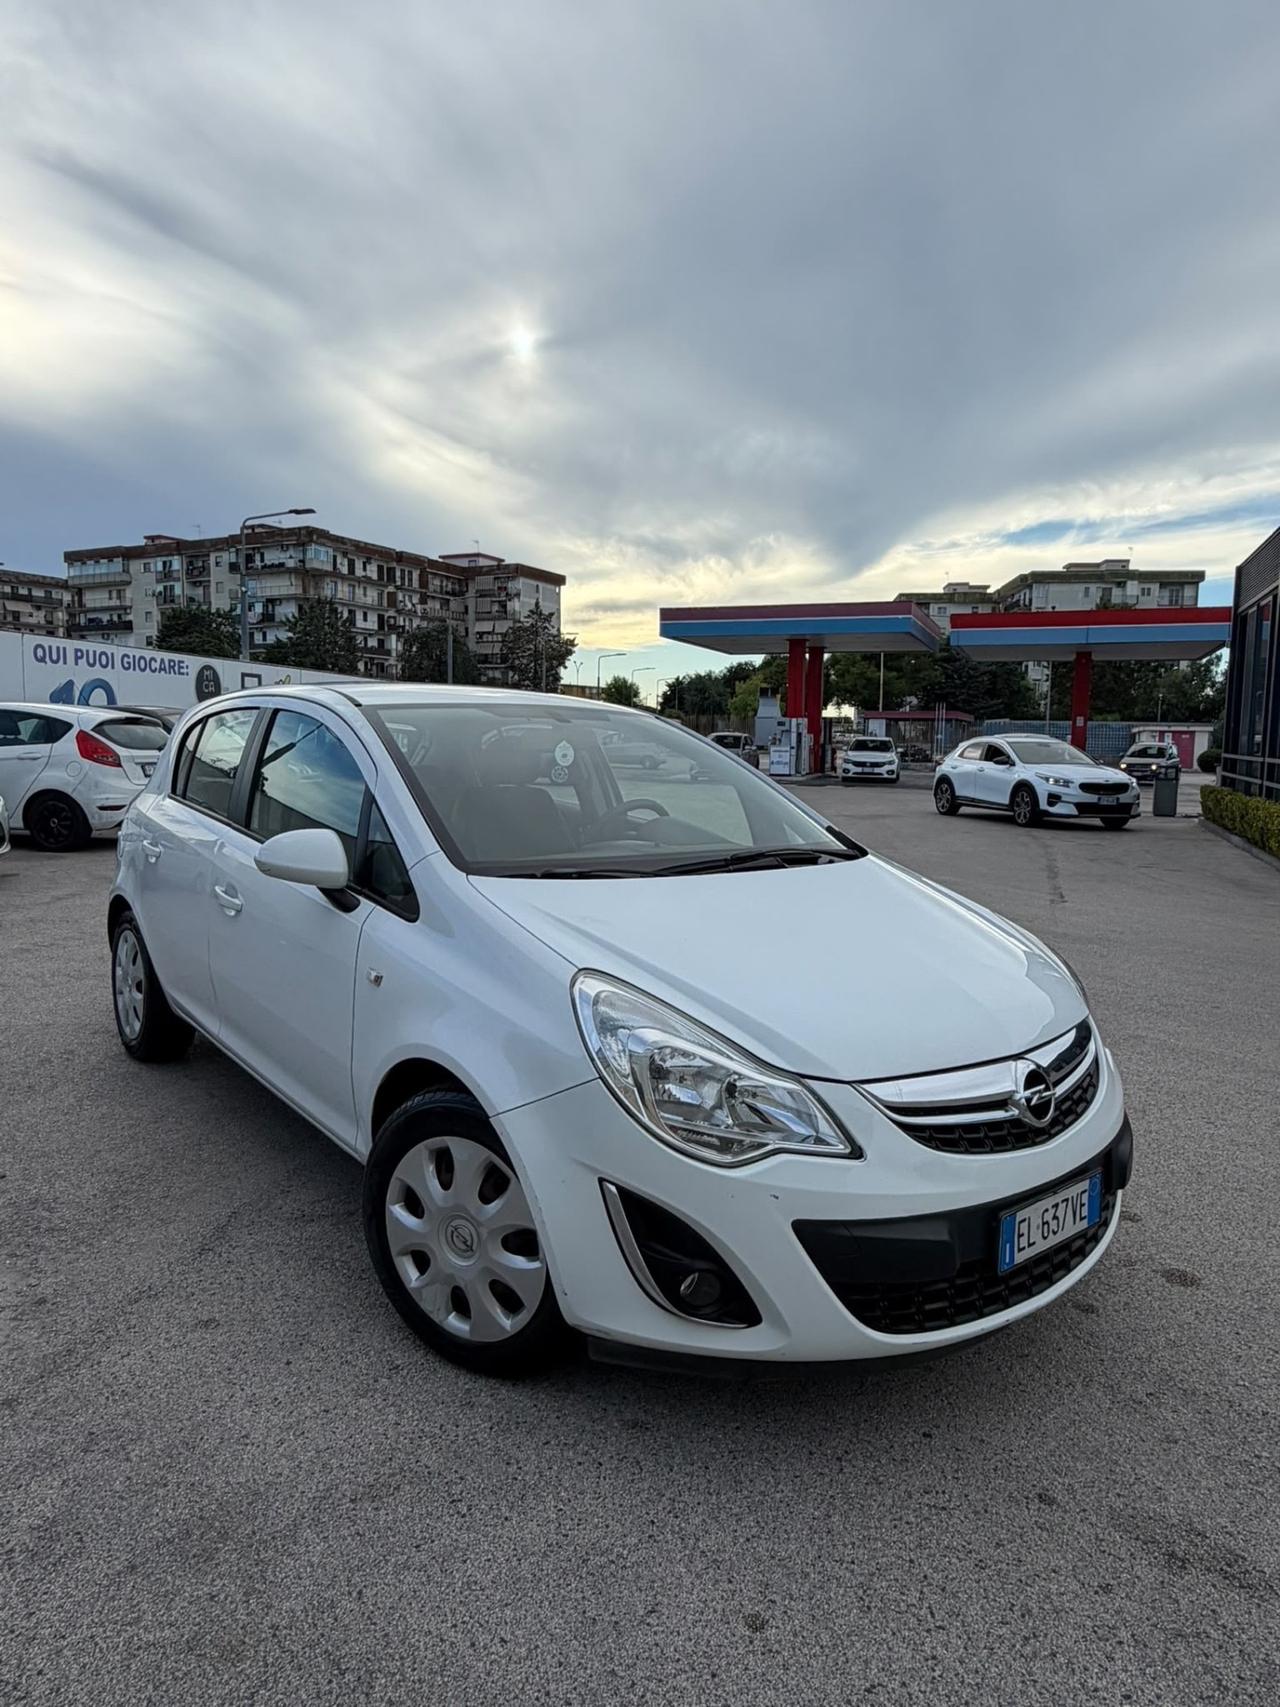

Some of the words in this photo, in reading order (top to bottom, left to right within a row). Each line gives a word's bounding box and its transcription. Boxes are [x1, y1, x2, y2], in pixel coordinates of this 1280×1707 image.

[33, 643, 67, 665] QUI
[74, 648, 115, 669] PUOI
[120, 653, 190, 676] GIOCARE:
